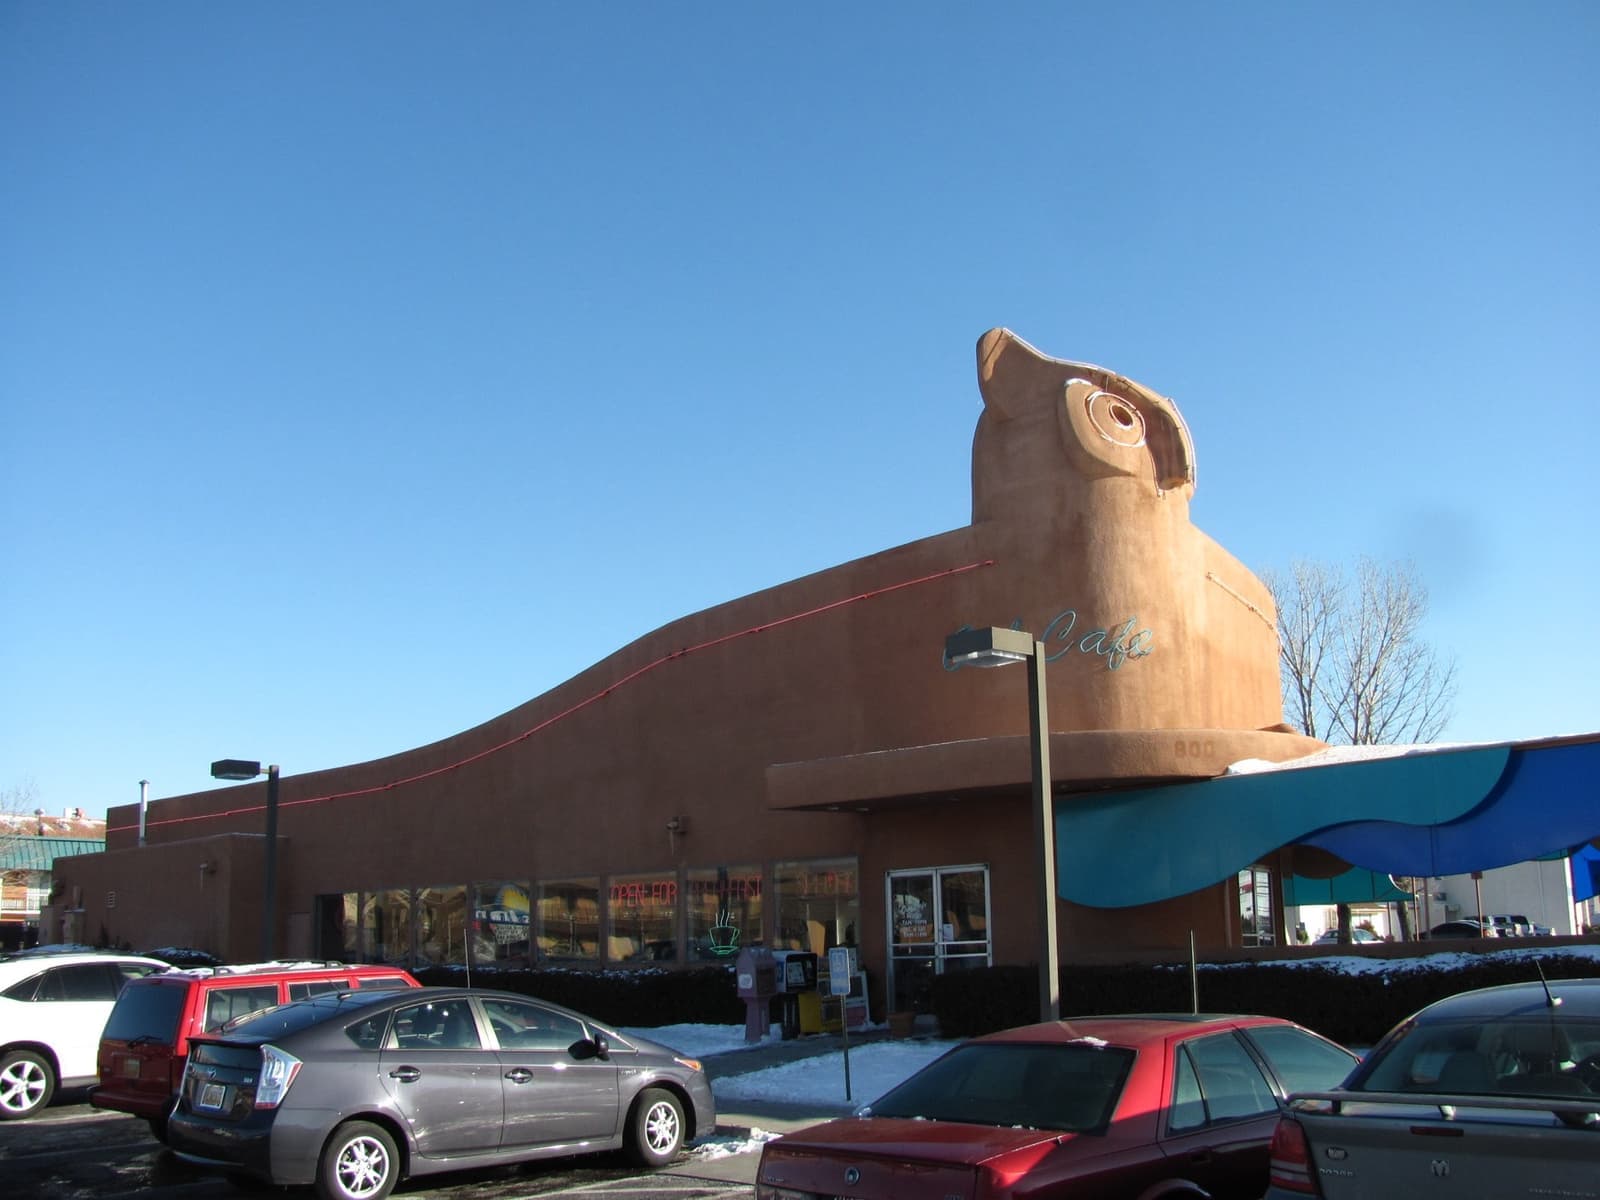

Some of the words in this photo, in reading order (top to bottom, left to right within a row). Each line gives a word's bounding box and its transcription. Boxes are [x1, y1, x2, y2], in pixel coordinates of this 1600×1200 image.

[1174, 740, 1215, 758] 800
[610, 881, 645, 908] OPEN
[652, 880, 680, 905] FOR
